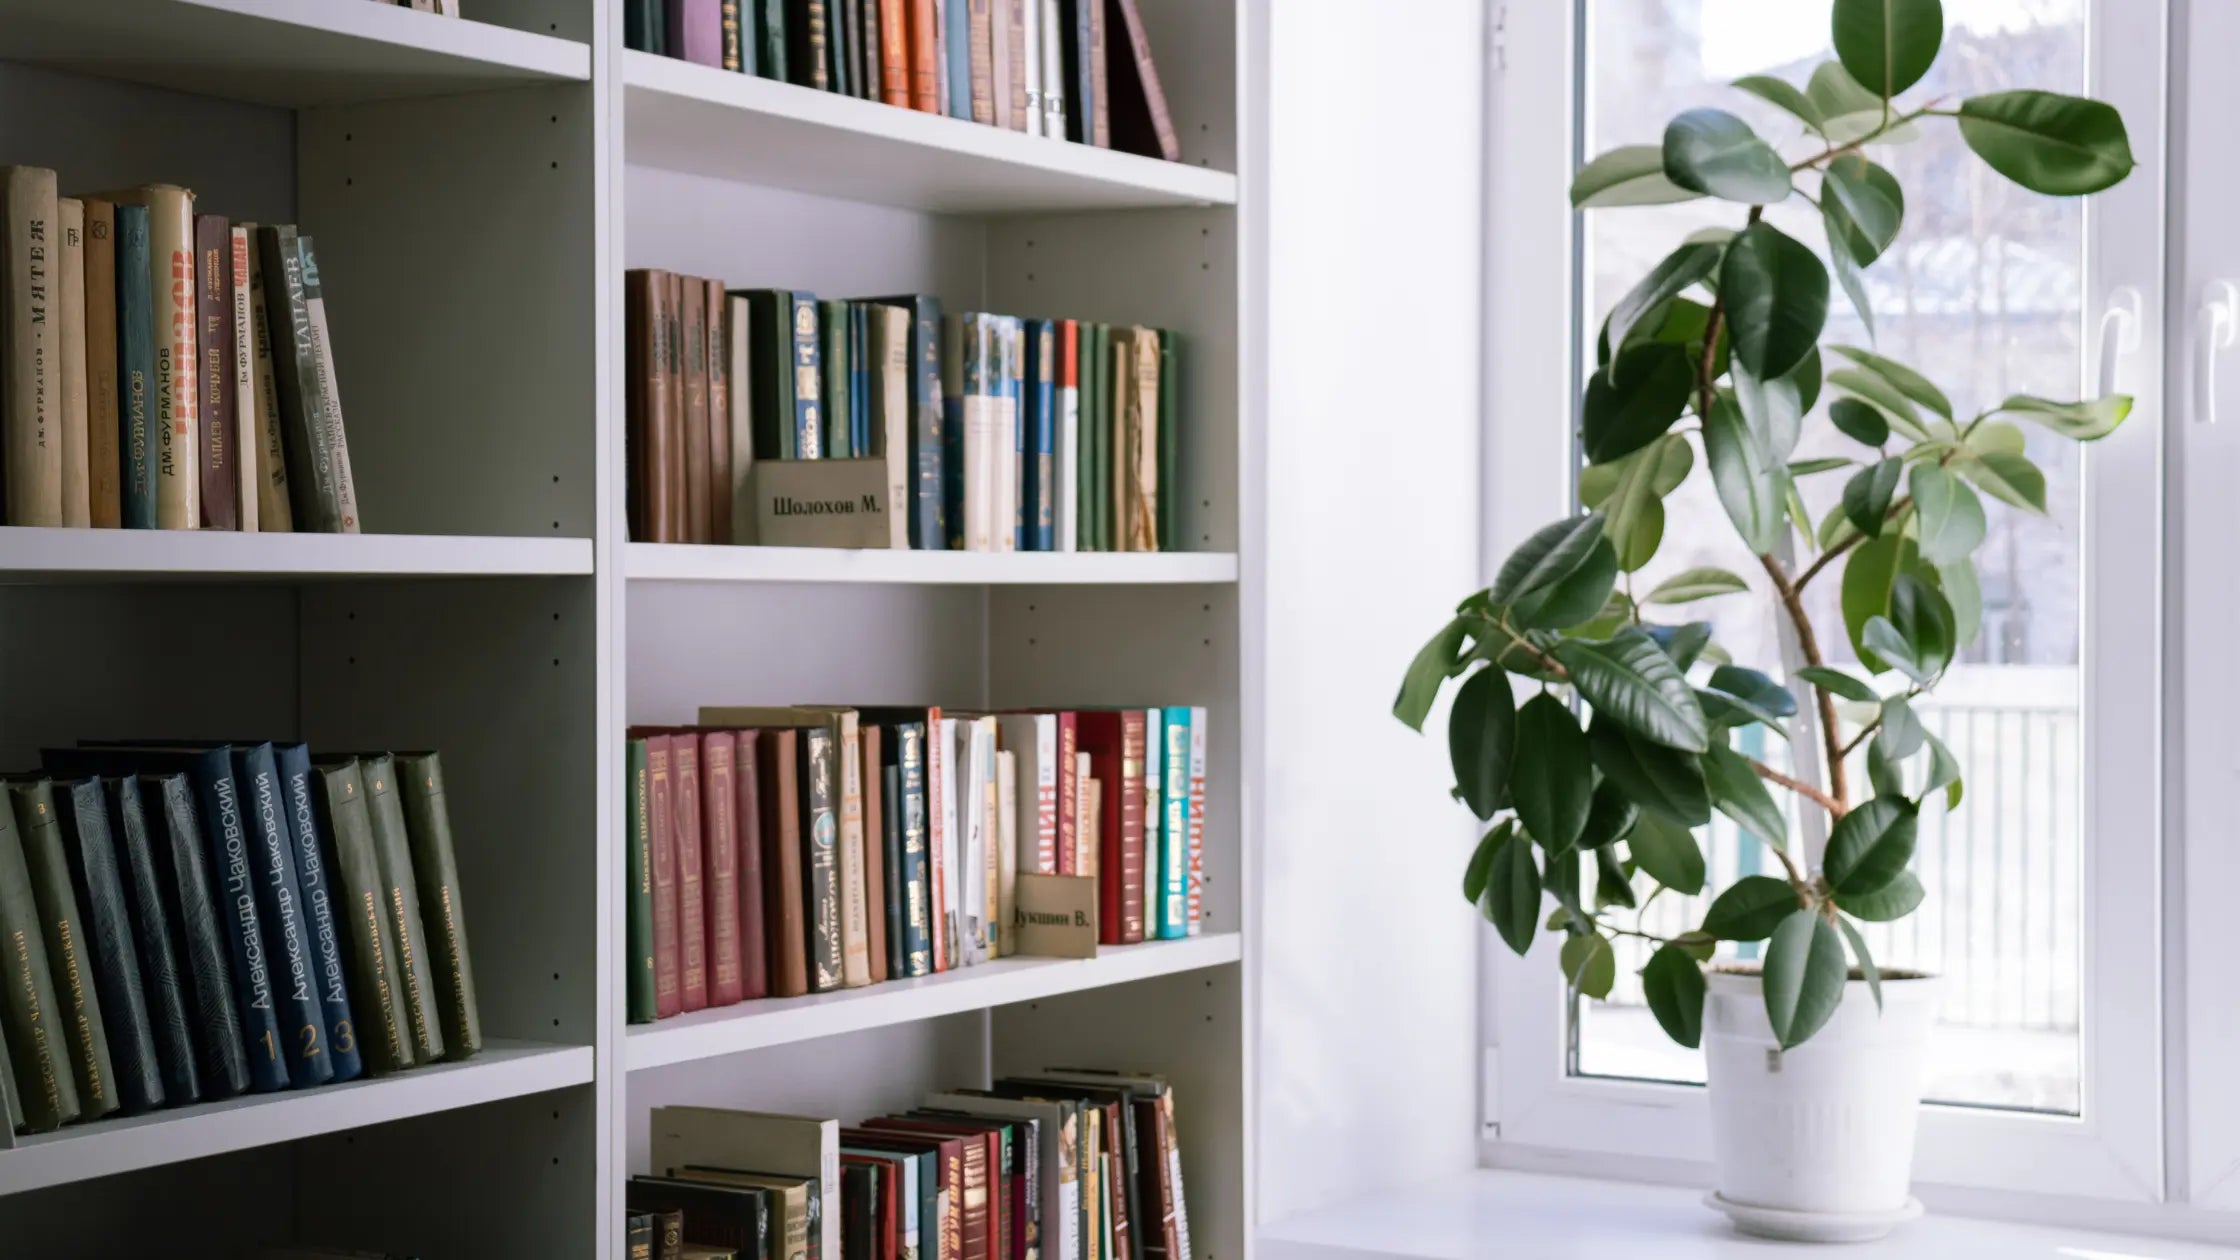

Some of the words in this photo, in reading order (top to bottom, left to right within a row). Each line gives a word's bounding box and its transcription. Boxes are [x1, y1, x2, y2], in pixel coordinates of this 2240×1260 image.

[30, 220, 45, 325] МЯТЕЖ
[232, 237, 246, 287] ЧАПАЕВ
[237, 293, 248, 367] ФУРМАНОВ
[286, 257, 311, 356] ЧАПАЕВ
[35, 348, 44, 423] ФУРМАНОВ
[209, 348, 221, 403] КОЧУБЕЙ
[211, 421, 222, 469] ЧАПАЕВ
[806, 407, 817, 459] ОХОВ
[773, 497, 855, 517] Шолохов
[860, 495, 882, 514] М.
[214, 778, 247, 892] Чаковский
[256, 772, 285, 885] Чаковский
[291, 773, 320, 887] Чаковский
[639, 770, 648, 839] ШОЛОХОВ
[1039, 785, 1055, 874] КШИН
[1189, 776, 1204, 920] ШУКШИН
[238, 895, 270, 1009] Александр
[277, 888, 309, 1001] Александр
[312, 889, 344, 1003] Александр
[364, 891, 385, 974] ЧАКОВСКИЙ
[393, 887, 413, 968] ЧАКОВСКИЙ
[440, 885, 459, 966] ЧАКОВСКИЙ
[1074, 909, 1090, 927] В.
[12, 930, 40, 1021] ЧАКОВСКИЙ
[58, 919, 84, 1009] ЧАКОВСКИЙ
[260, 1030, 276, 1062] 1
[300, 1024, 320, 1057] 2
[335, 1020, 353, 1053] 3
[379, 979, 400, 1058] АЛЕКСАНДР
[407, 973, 429, 1049] АЛЕКСАНДР
[78, 1015, 103, 1100] АЛЕКСАНДР
